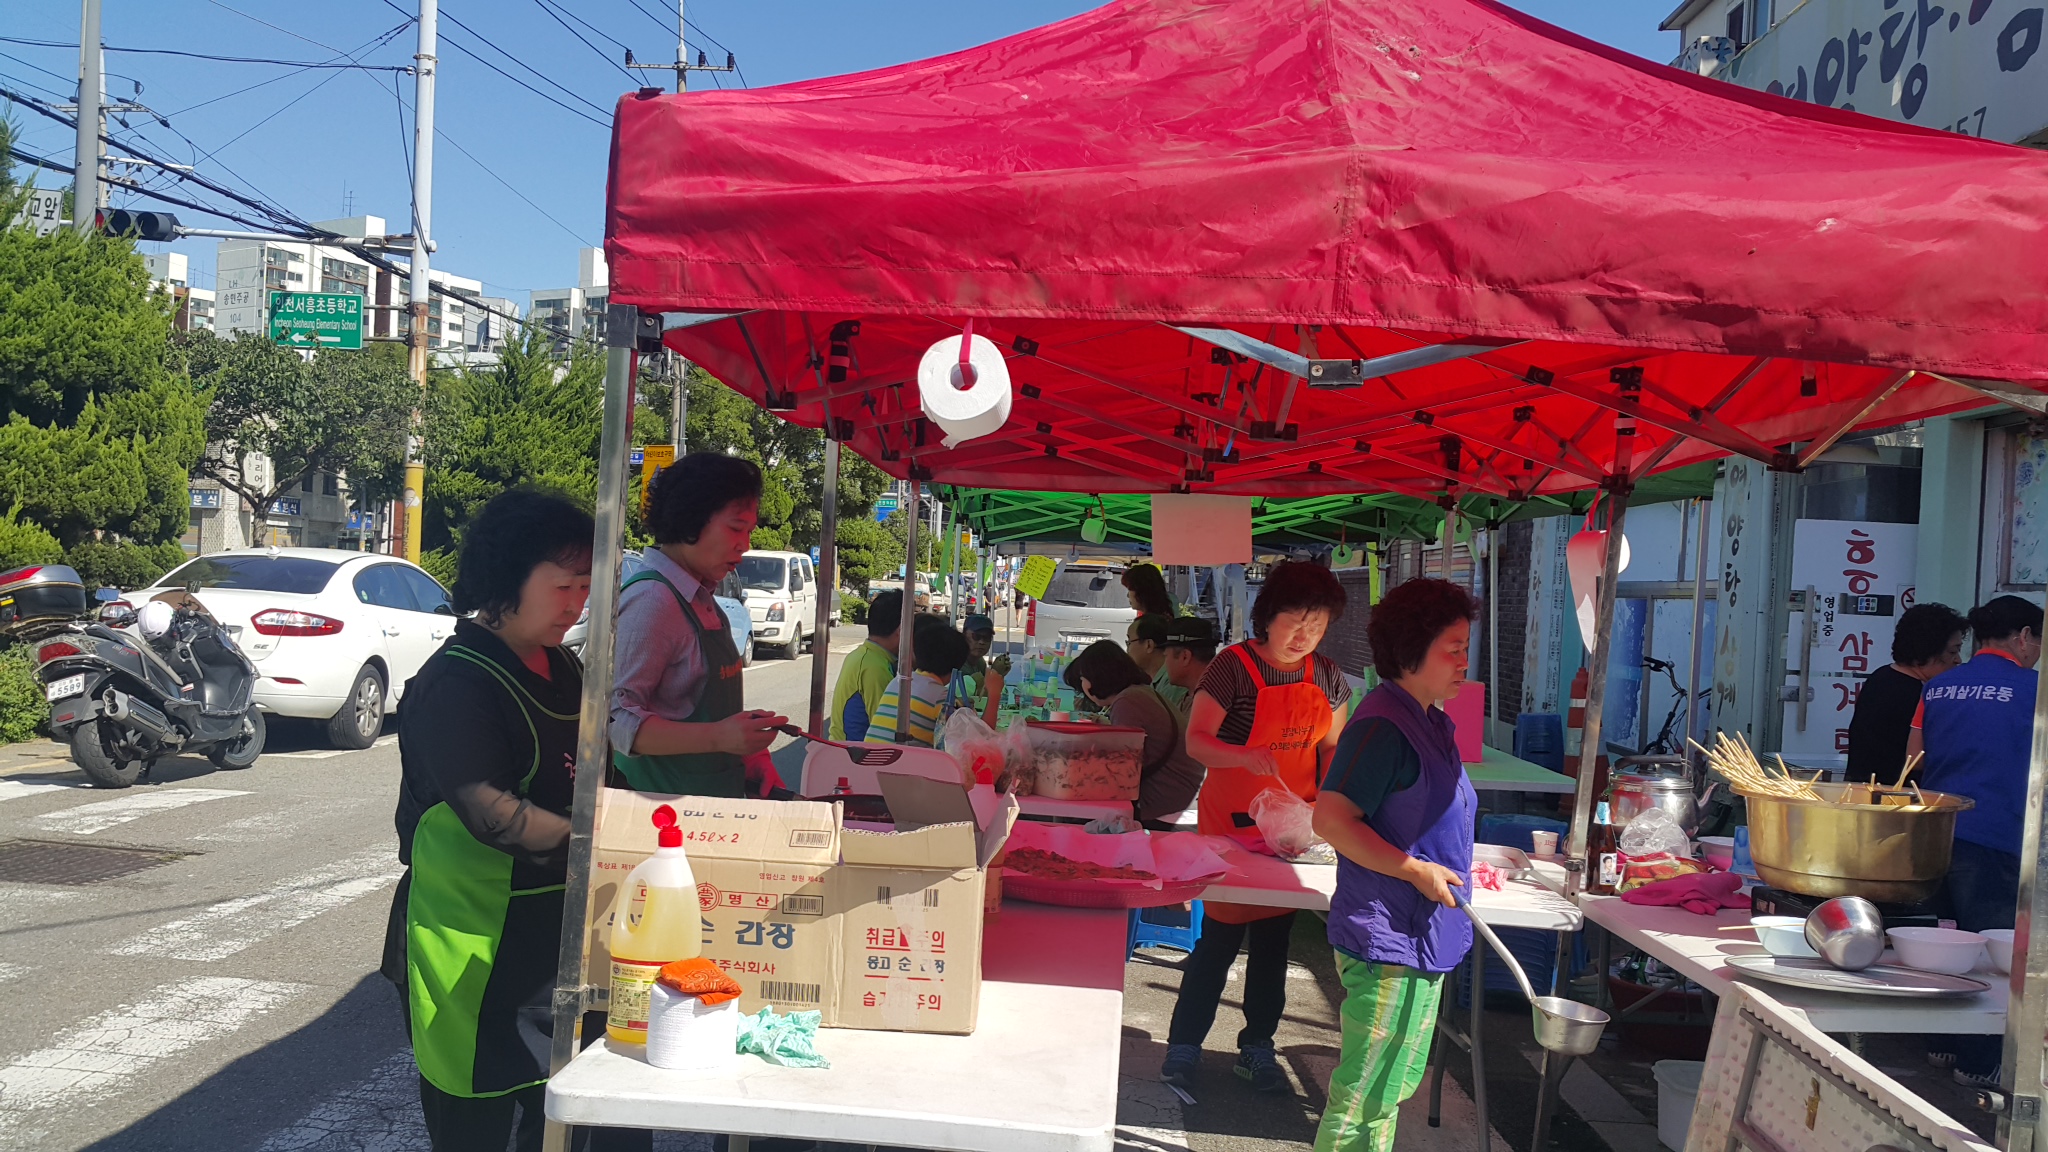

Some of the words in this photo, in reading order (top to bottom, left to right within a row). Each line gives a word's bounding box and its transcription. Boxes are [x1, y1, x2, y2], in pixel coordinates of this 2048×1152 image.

[275, 296, 358, 315] 인천서흥초등학교
[229, 313, 241, 323] 104
[274, 318, 293, 328] Incheon
[293, 317, 315, 330] Seoheung
[316, 318, 340, 332] Elementary
[341, 319, 357, 331] School
[1822, 596, 1835, 637] 영업중
[57, 682, 81, 696] 5589
[1925, 685, 2014, 702] 바르게살기운동
[759, 872, 786, 881] 영업신고
[734, 920, 796, 950] 간장
[866, 927, 895, 946] 취급
[867, 955, 891, 970] 몽고
[898, 956, 912, 972] 순
